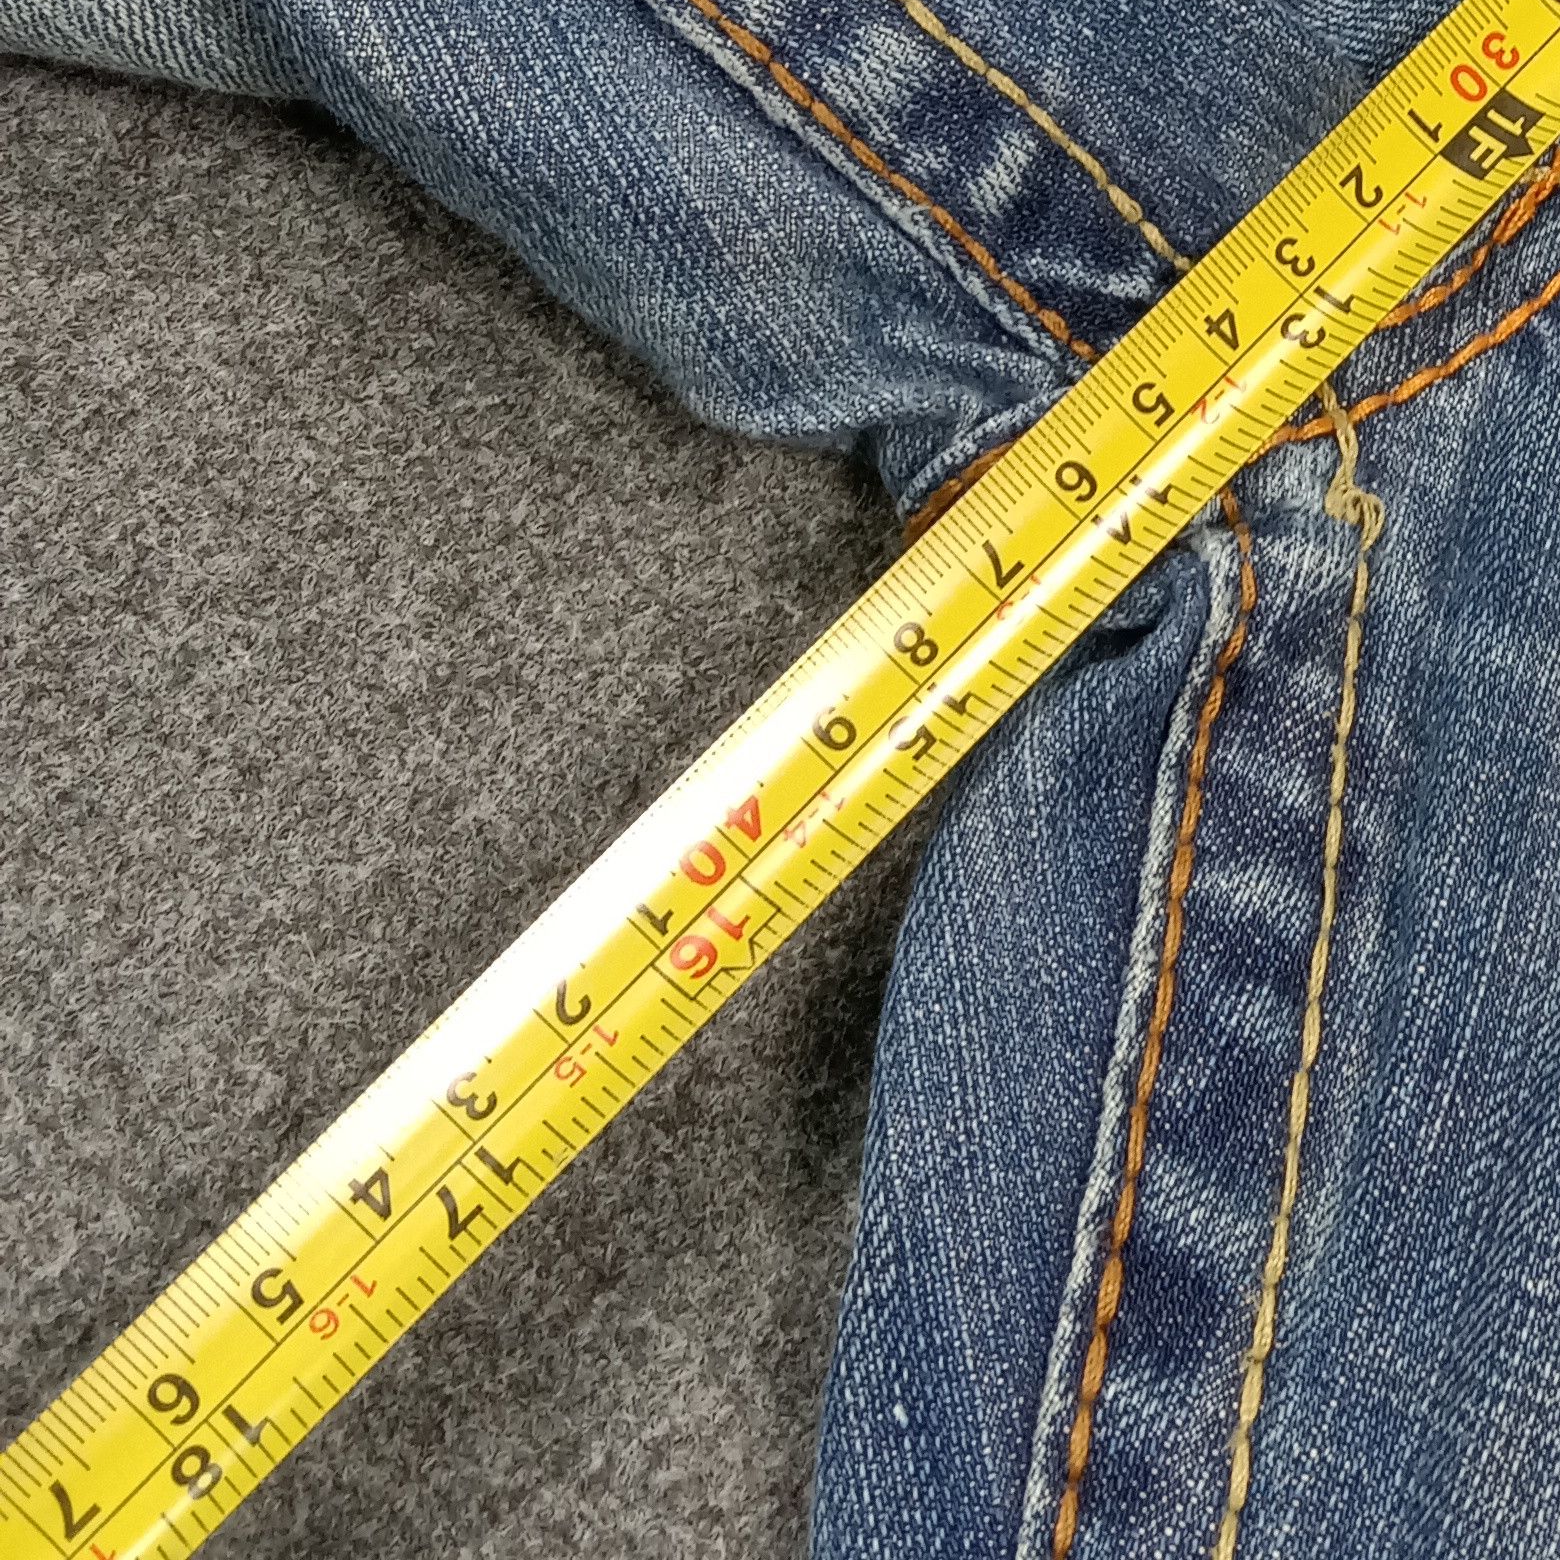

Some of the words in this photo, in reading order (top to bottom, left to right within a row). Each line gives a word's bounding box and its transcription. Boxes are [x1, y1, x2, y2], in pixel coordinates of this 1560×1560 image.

[1449, 30, 1520, 103] 30
[1407, 109, 1444, 144] 1
[1466, 107, 1528, 172] 1F
[1339, 164, 1384, 209] 2
[1275, 237, 1316, 278] 3
[1204, 307, 1240, 351] 4
[1280, 285, 1357, 349] 13
[1131, 381, 1176, 428] 5
[1054, 459, 1099, 504] 6
[981, 539, 1025, 590] 7
[893, 621, 939, 668] 8
[812, 706, 857, 751] 9
[679, 794, 763, 887] 40
[635, 902, 675, 937] 1
[669, 905, 752, 980] 16
[446, 1071, 498, 1121] 3
[347, 1166, 393, 1222] 4
[435, 1145, 521, 1241] 17
[251, 1267, 305, 1326] 5
[147, 1372, 200, 1426] 6
[170, 1403, 270, 1501] 18
[48, 1478, 102, 1542] 7
